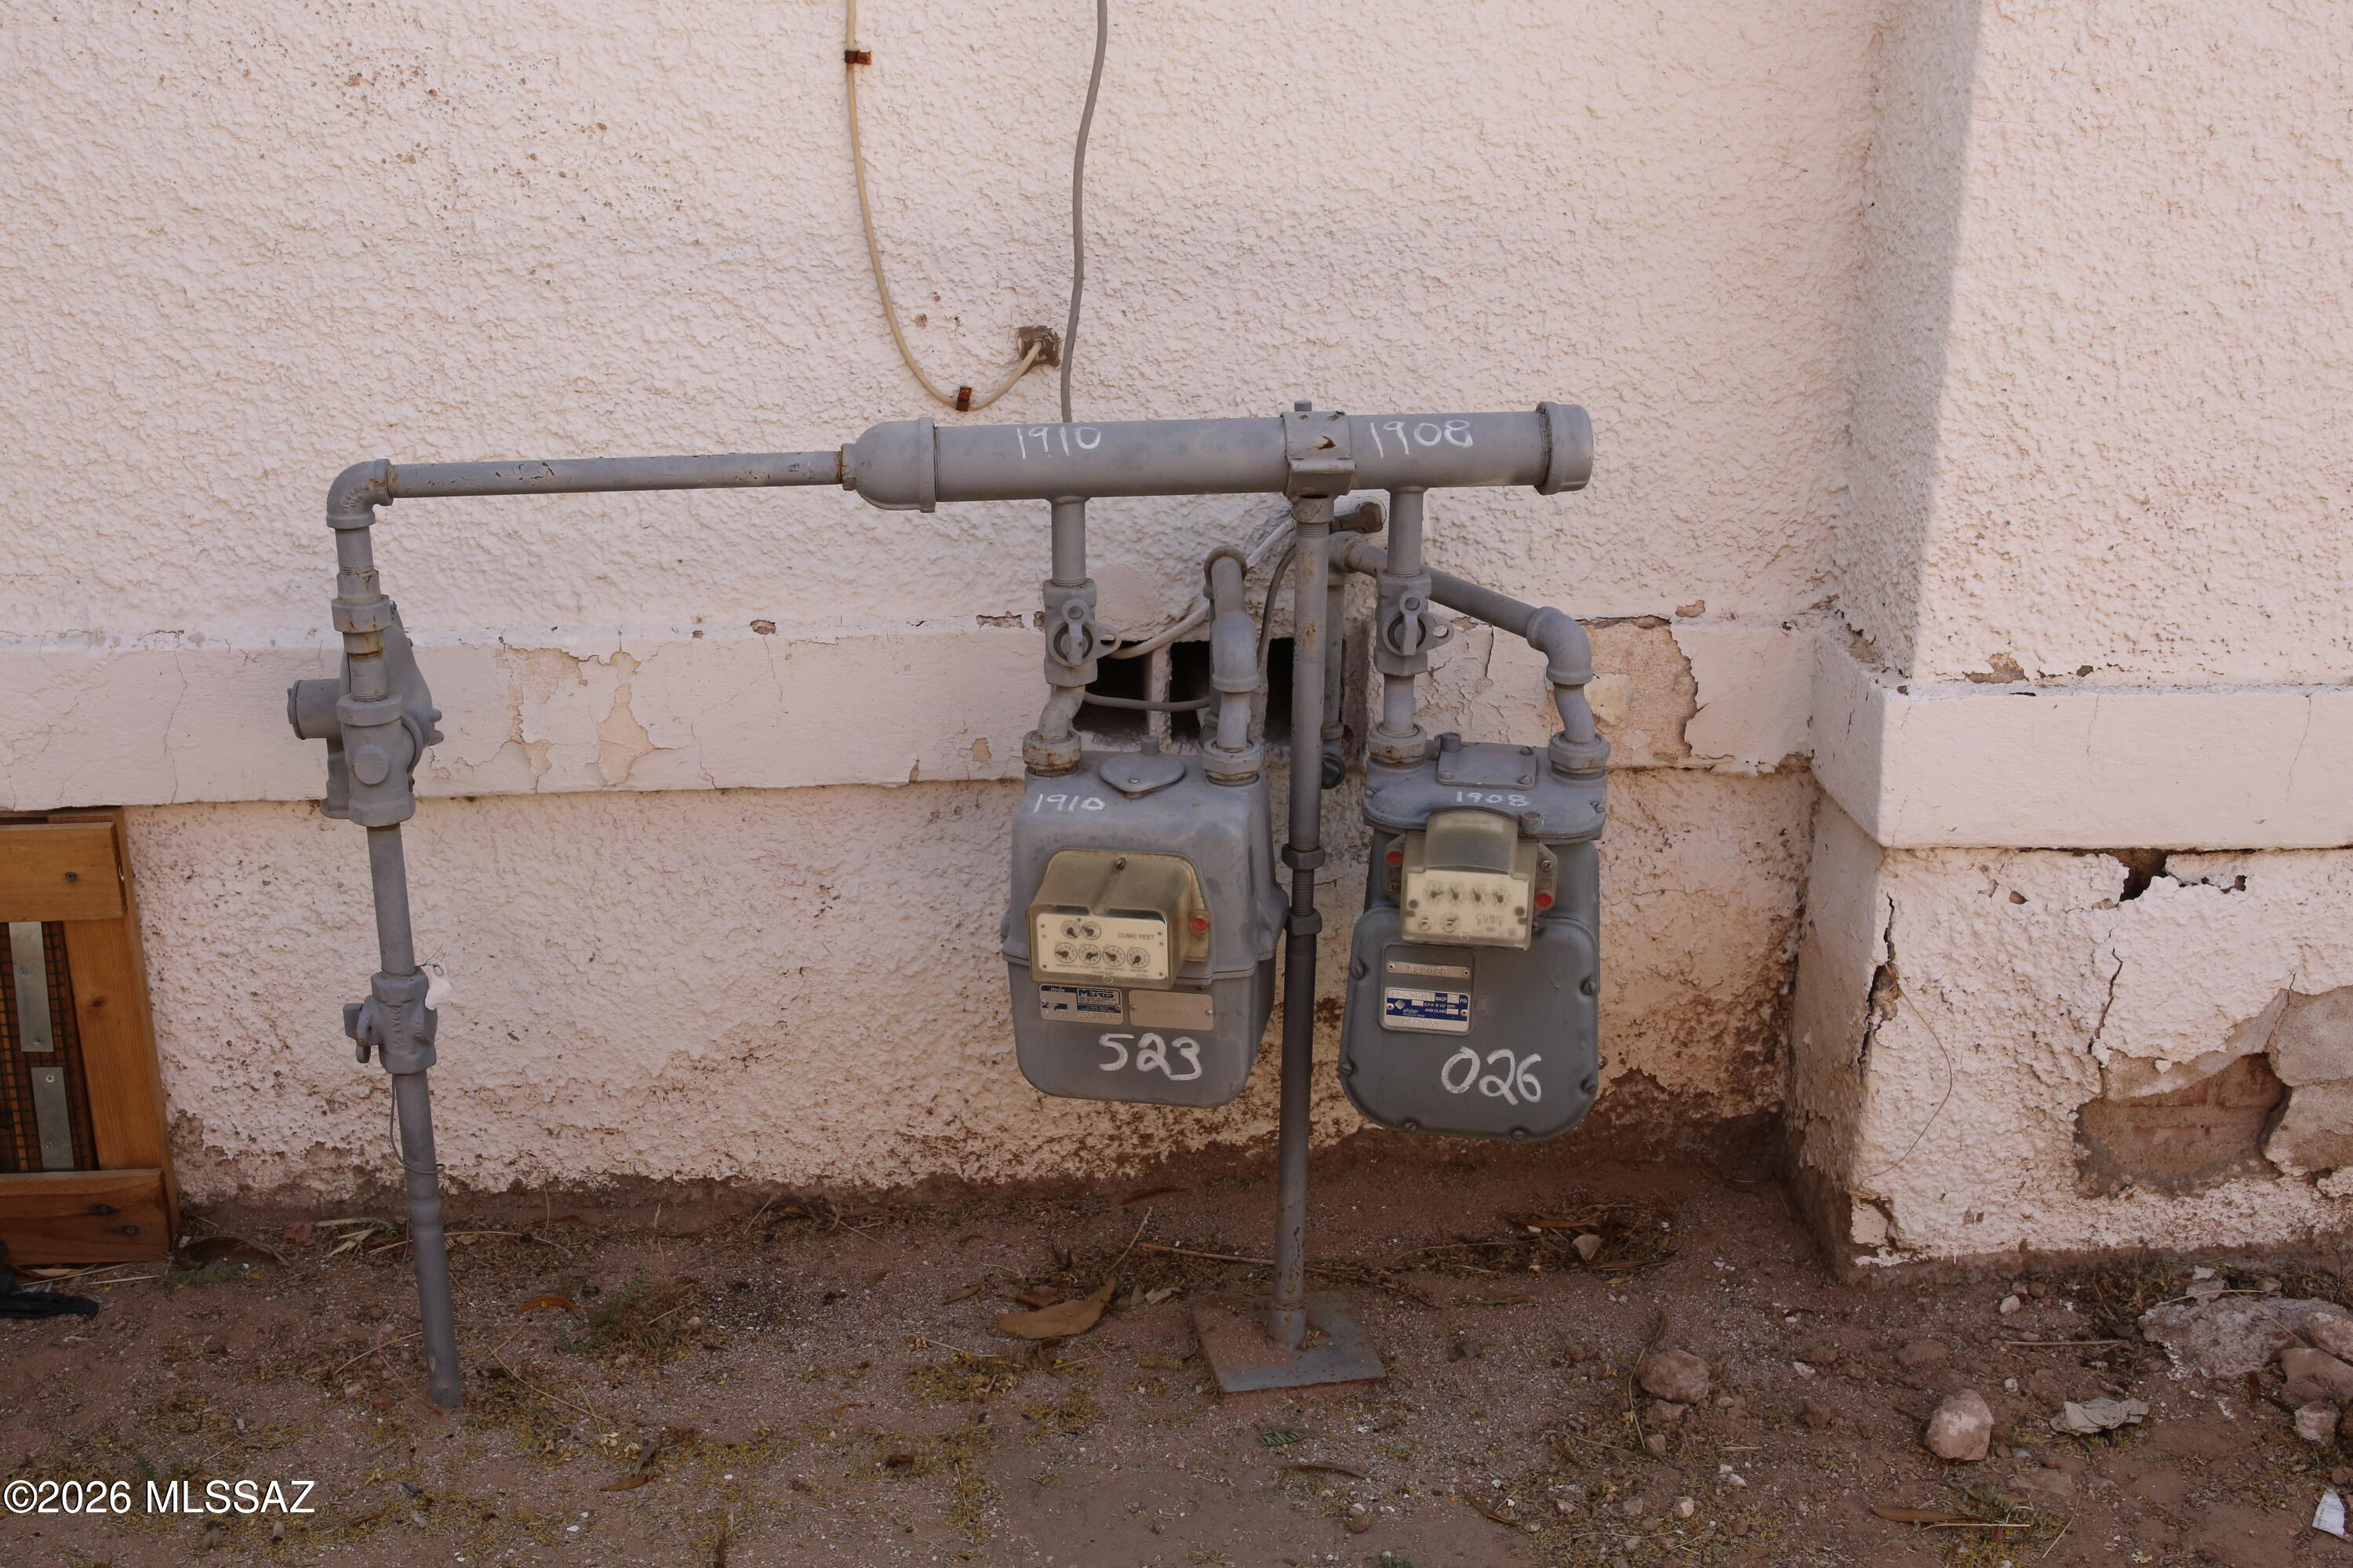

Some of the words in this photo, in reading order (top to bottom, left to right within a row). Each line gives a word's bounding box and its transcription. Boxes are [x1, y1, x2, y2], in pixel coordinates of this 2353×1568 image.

[1017, 427, 1101, 459] 1910
[1370, 420, 1473, 458] 1908
[1033, 794, 1105, 812] 1910
[1457, 791, 1529, 806] 1908
[1099, 1032, 1202, 1081] 523
[1441, 1046, 1542, 1105] 026
